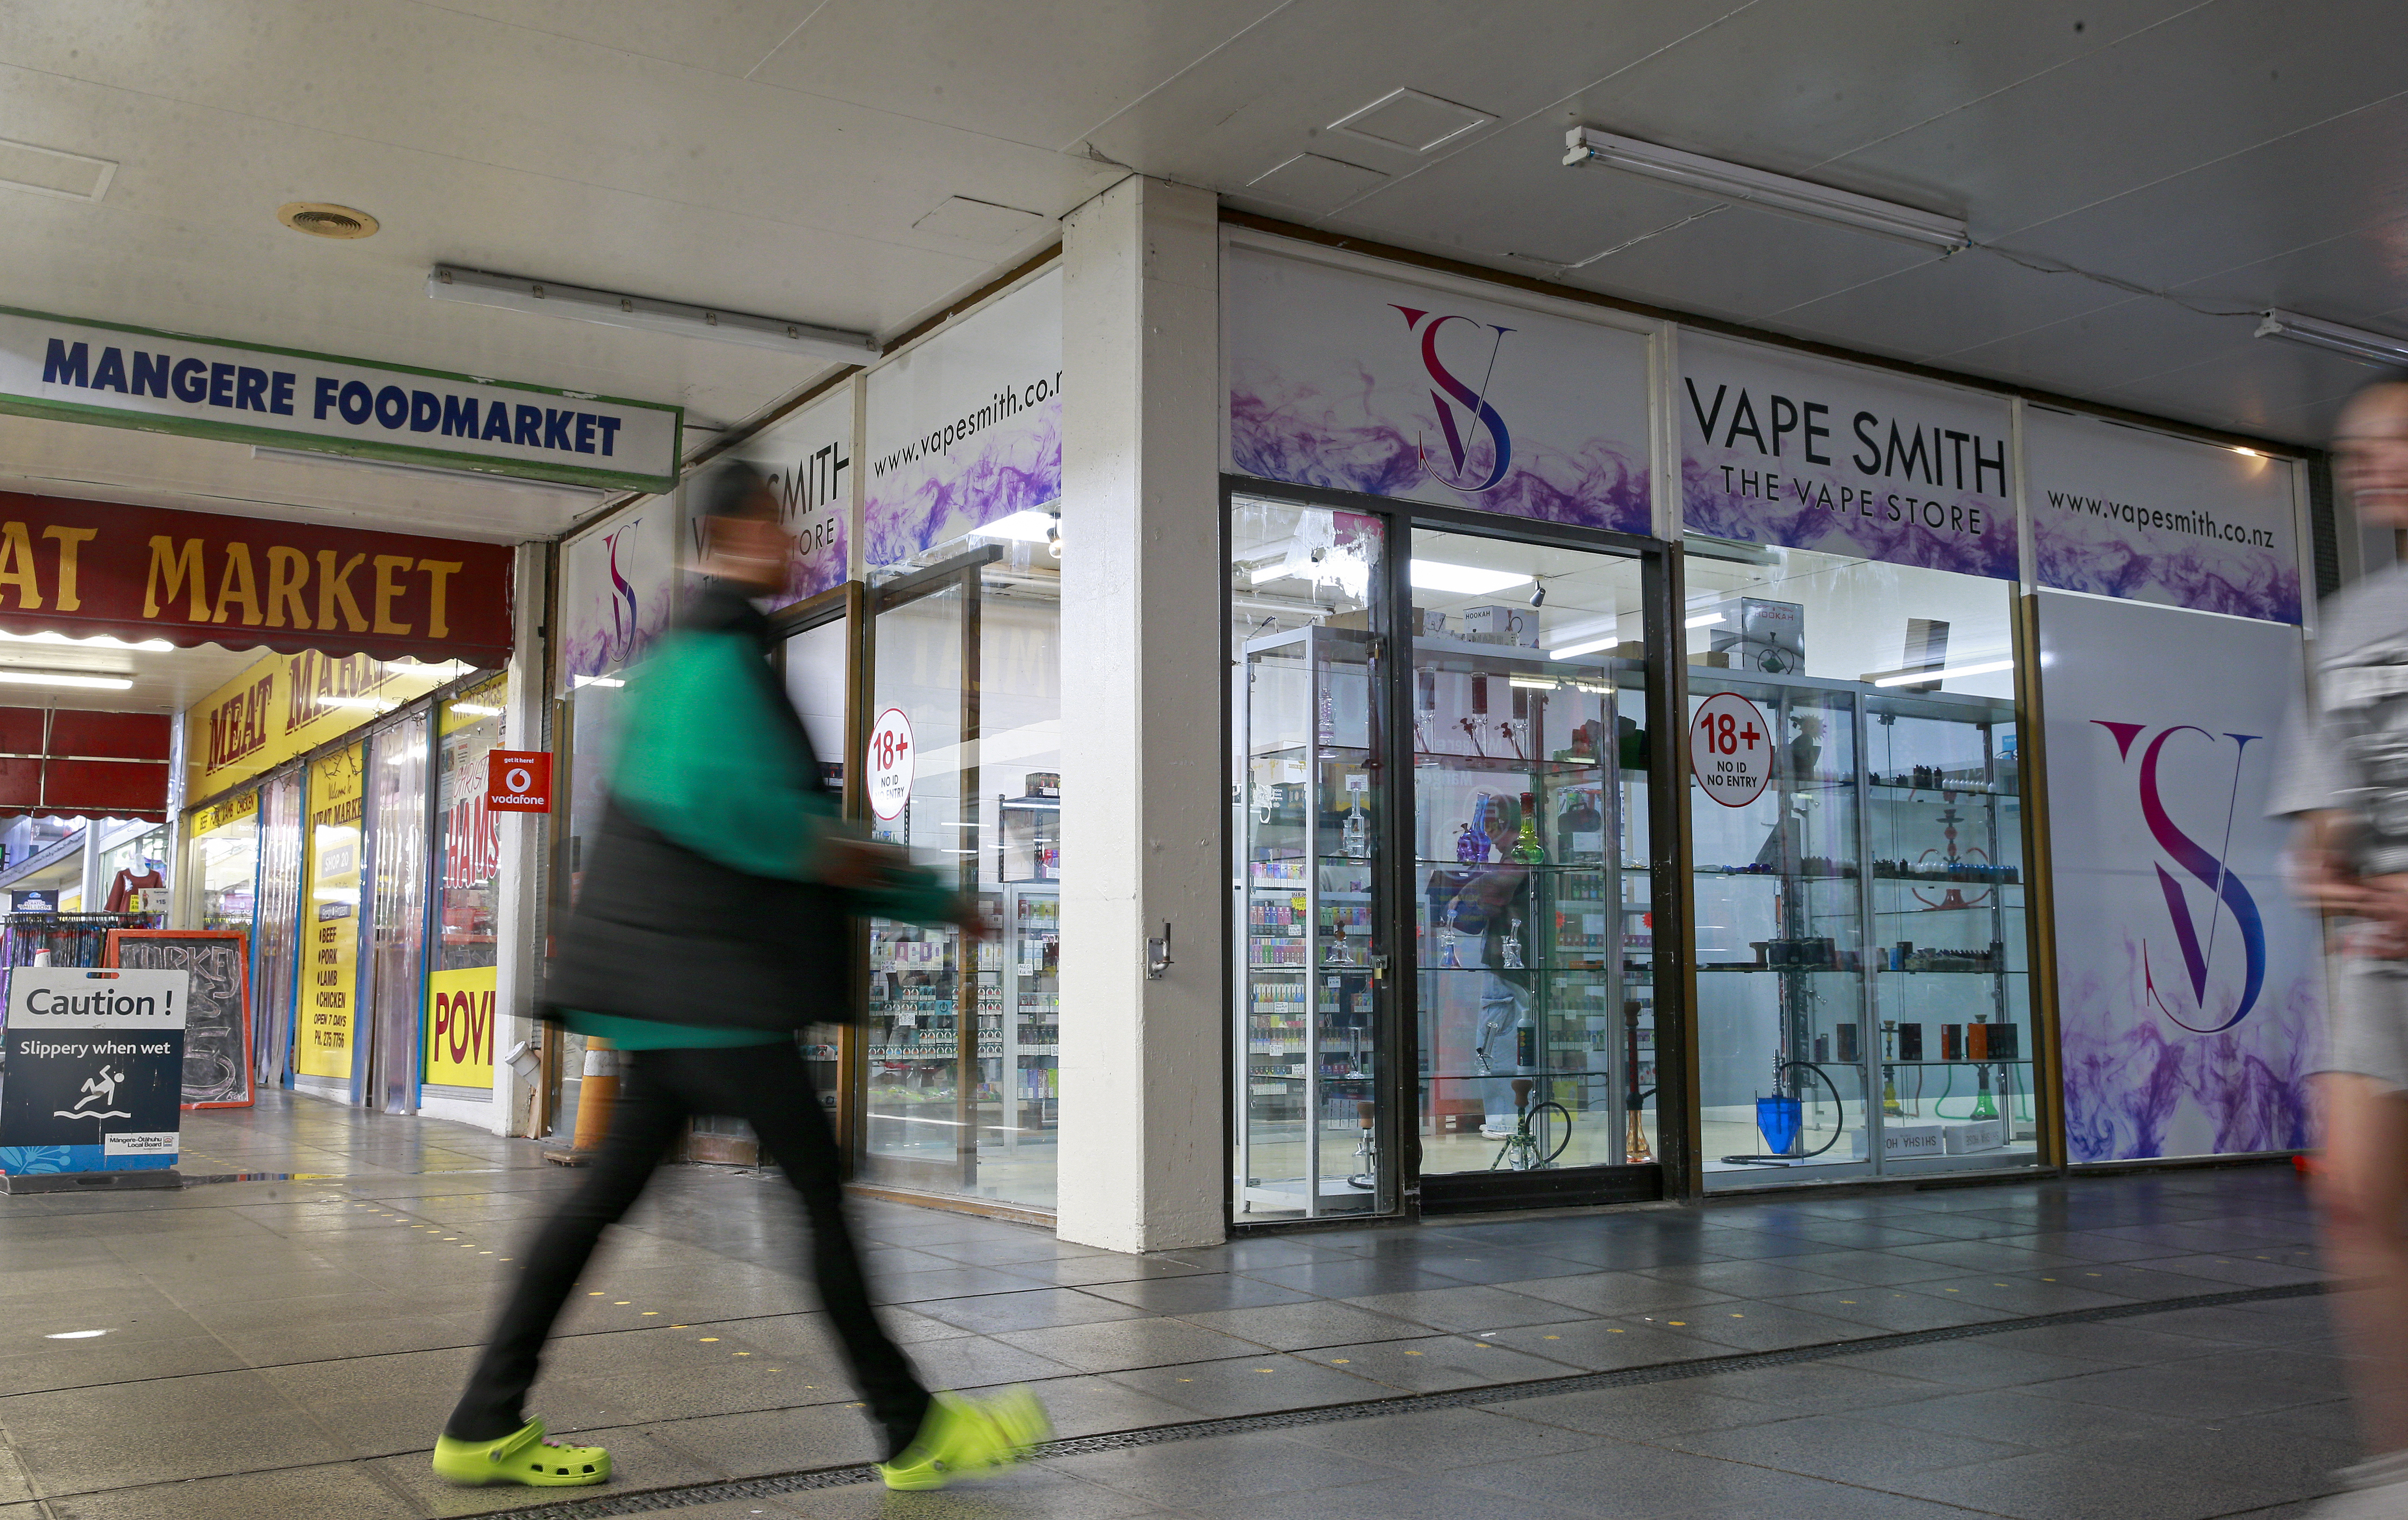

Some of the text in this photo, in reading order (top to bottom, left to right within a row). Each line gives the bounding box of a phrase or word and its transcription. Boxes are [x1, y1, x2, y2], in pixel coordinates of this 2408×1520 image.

[43, 338, 621, 457] MANGERE FOODMARKET
[874, 370, 1062, 479] www.vapesmith.co.
[1685, 377, 2006, 497] VAPE SMITH
[1721, 465, 1981, 535] THE VAPE STORE
[2048, 490, 2274, 548] www.vapesmith.co.nz
[143, 535, 463, 639] MARKET
[1466, 610, 1491, 620] HOOKAH
[1754, 611, 1794, 621] HOOKAH
[206, 673, 274, 776] MEAT
[1701, 712, 1760, 755] 18+
[873, 730, 908, 771] 18+
[1717, 761, 1747, 773] NO ID
[881, 774, 898, 787] NO ID
[1707, 774, 1757, 787] NO ENTRY
[491, 794, 544, 804] vodafone
[886, 786, 905, 800] ENTRY
[325, 851, 349, 872] SHOP 20
[322, 927, 337, 943] BEEF
[321, 948, 337, 965] PORK
[320, 971, 337, 986] LAMB
[26, 988, 155, 1016] Caution
[166, 990, 172, 1016] !
[320, 992, 345, 1009] CHICKEN
[314, 1013, 347, 1027] OPEN 7 DAYS
[323, 1031, 332, 1048] 275
[333, 1031, 344, 1048] 7756
[20, 1040, 171, 1059] Slippery when wet
[1904, 1135, 1937, 1148] SHISHA
